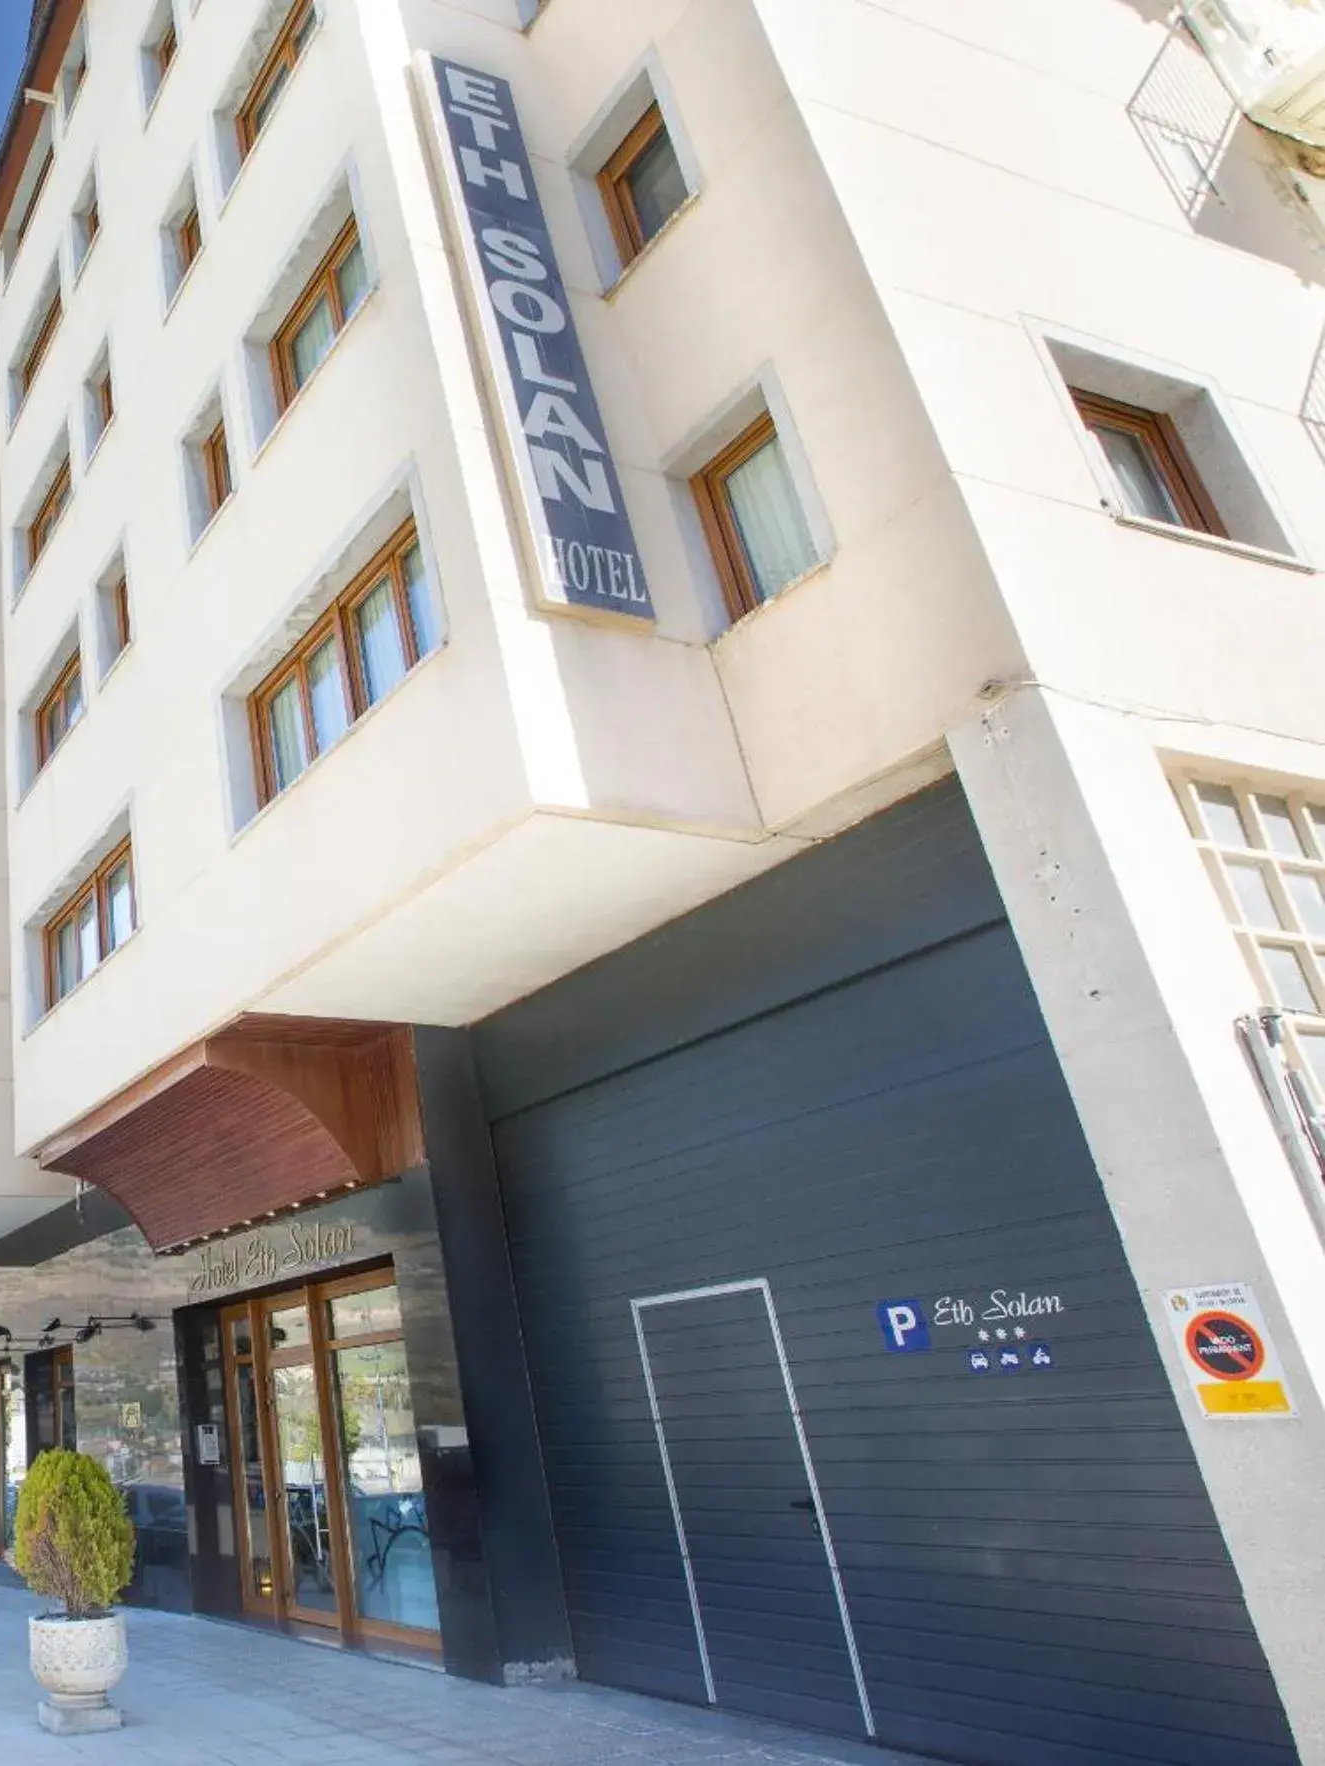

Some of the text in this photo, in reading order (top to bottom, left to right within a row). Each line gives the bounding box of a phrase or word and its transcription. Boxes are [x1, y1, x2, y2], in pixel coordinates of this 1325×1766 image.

[444, 65, 616, 515] ETH SOLAN
[547, 537, 647, 603] HOTEL
[190, 1246, 239, 1291] Hotel
[282, 1221, 356, 1269] Solan
[887, 1306, 917, 1347] P
[982, 1288, 1065, 1320] Solan
